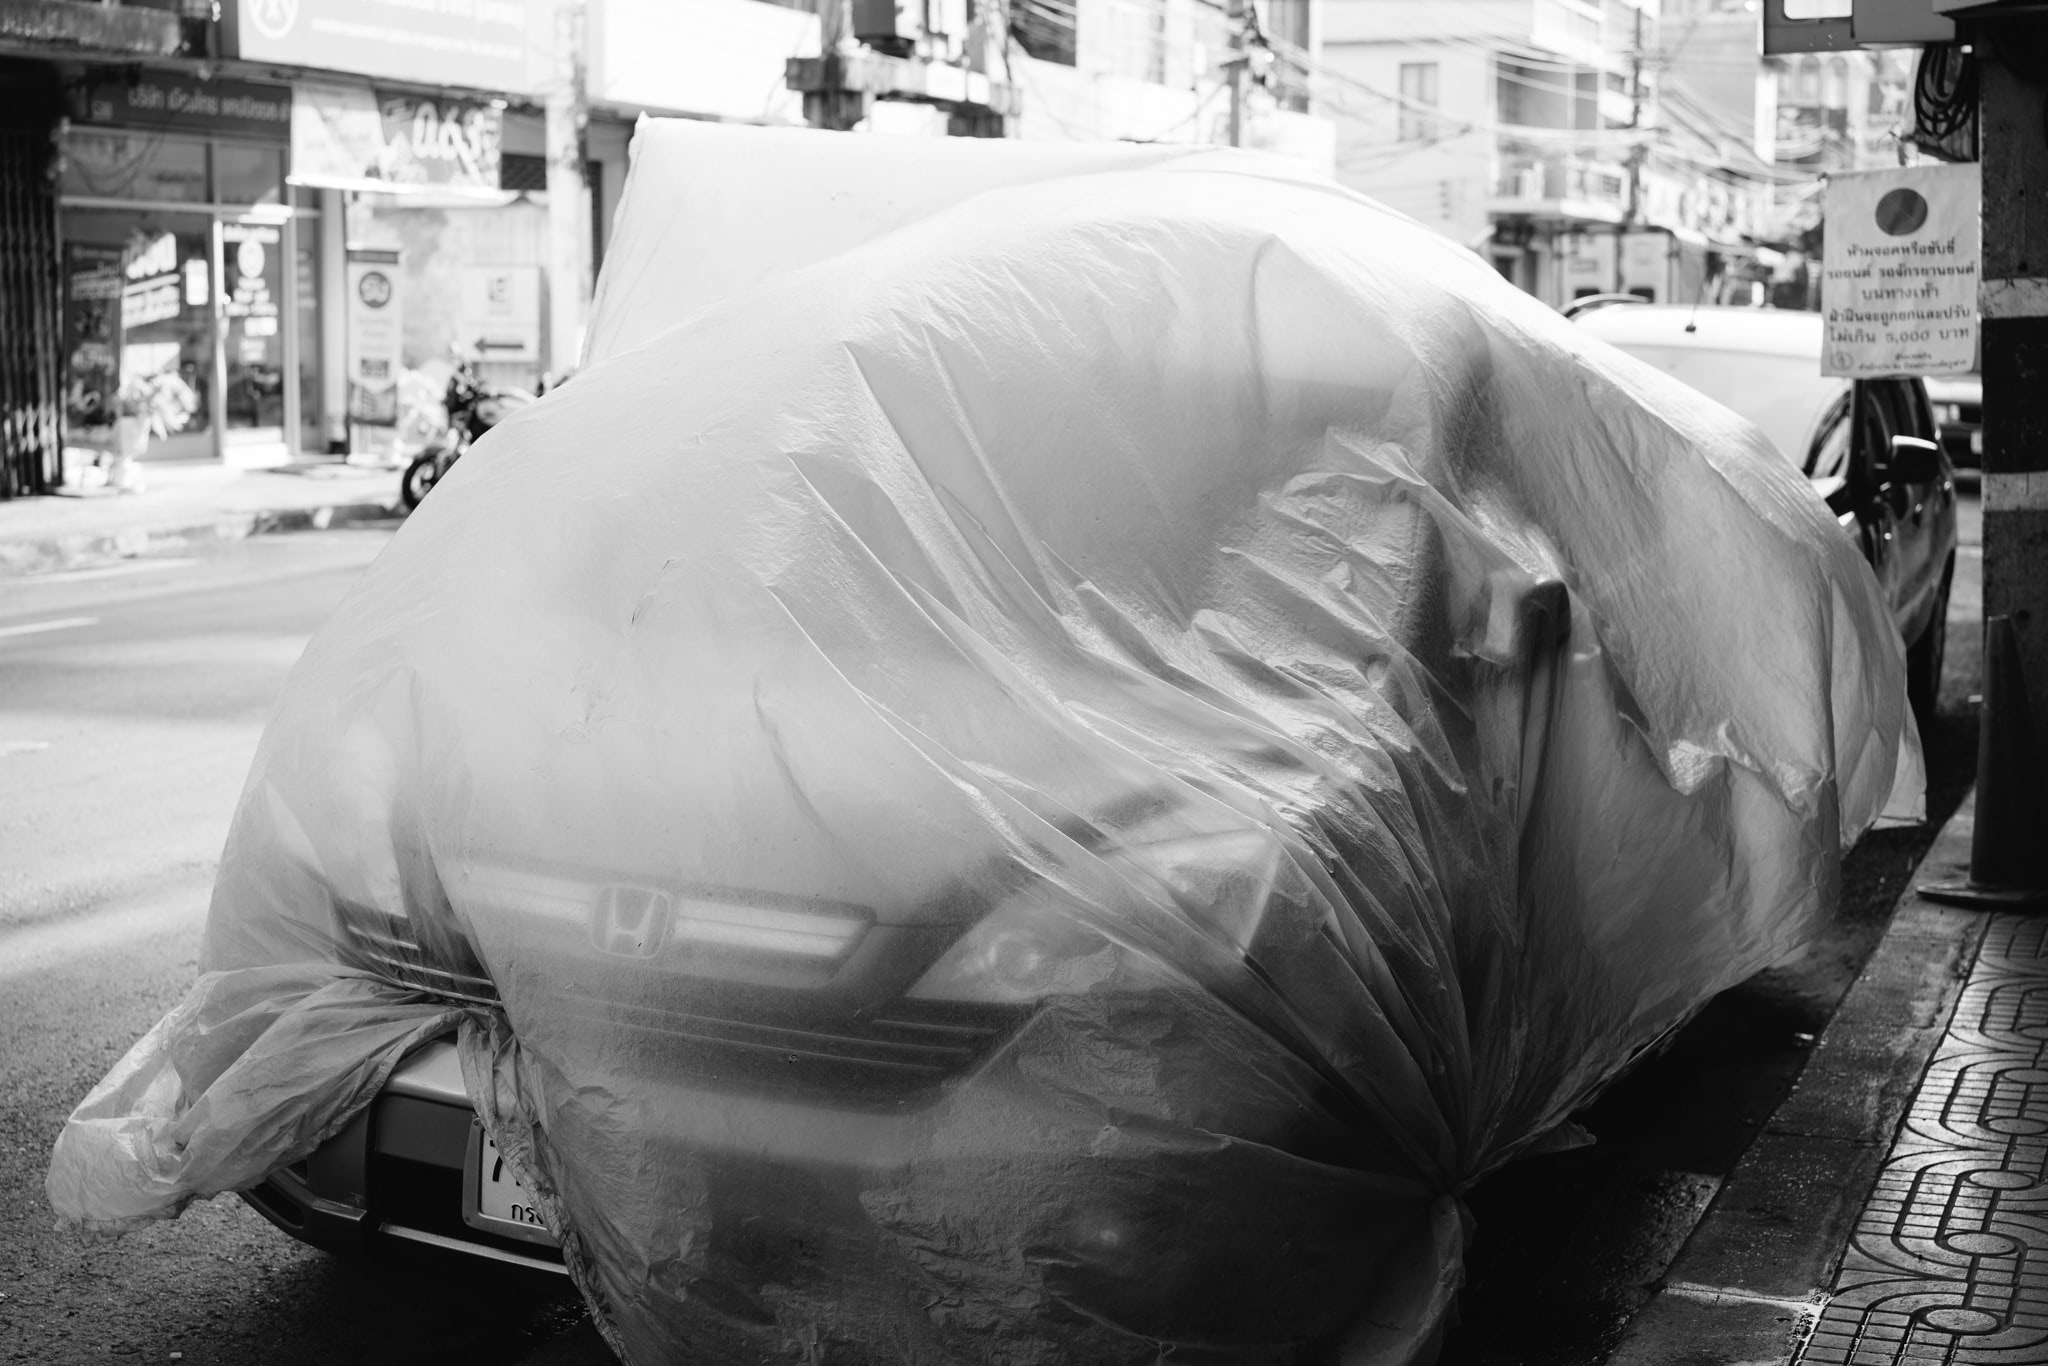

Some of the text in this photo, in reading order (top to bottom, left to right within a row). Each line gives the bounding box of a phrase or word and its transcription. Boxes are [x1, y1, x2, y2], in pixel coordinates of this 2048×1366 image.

[1827, 261, 1975, 279] รถยนต์ รถจักรยานยนต์
[1862, 283, 1940, 300] บนทางเท้า
[1829, 326, 1970, 343] ไม่เกิน 5,000 บาท
